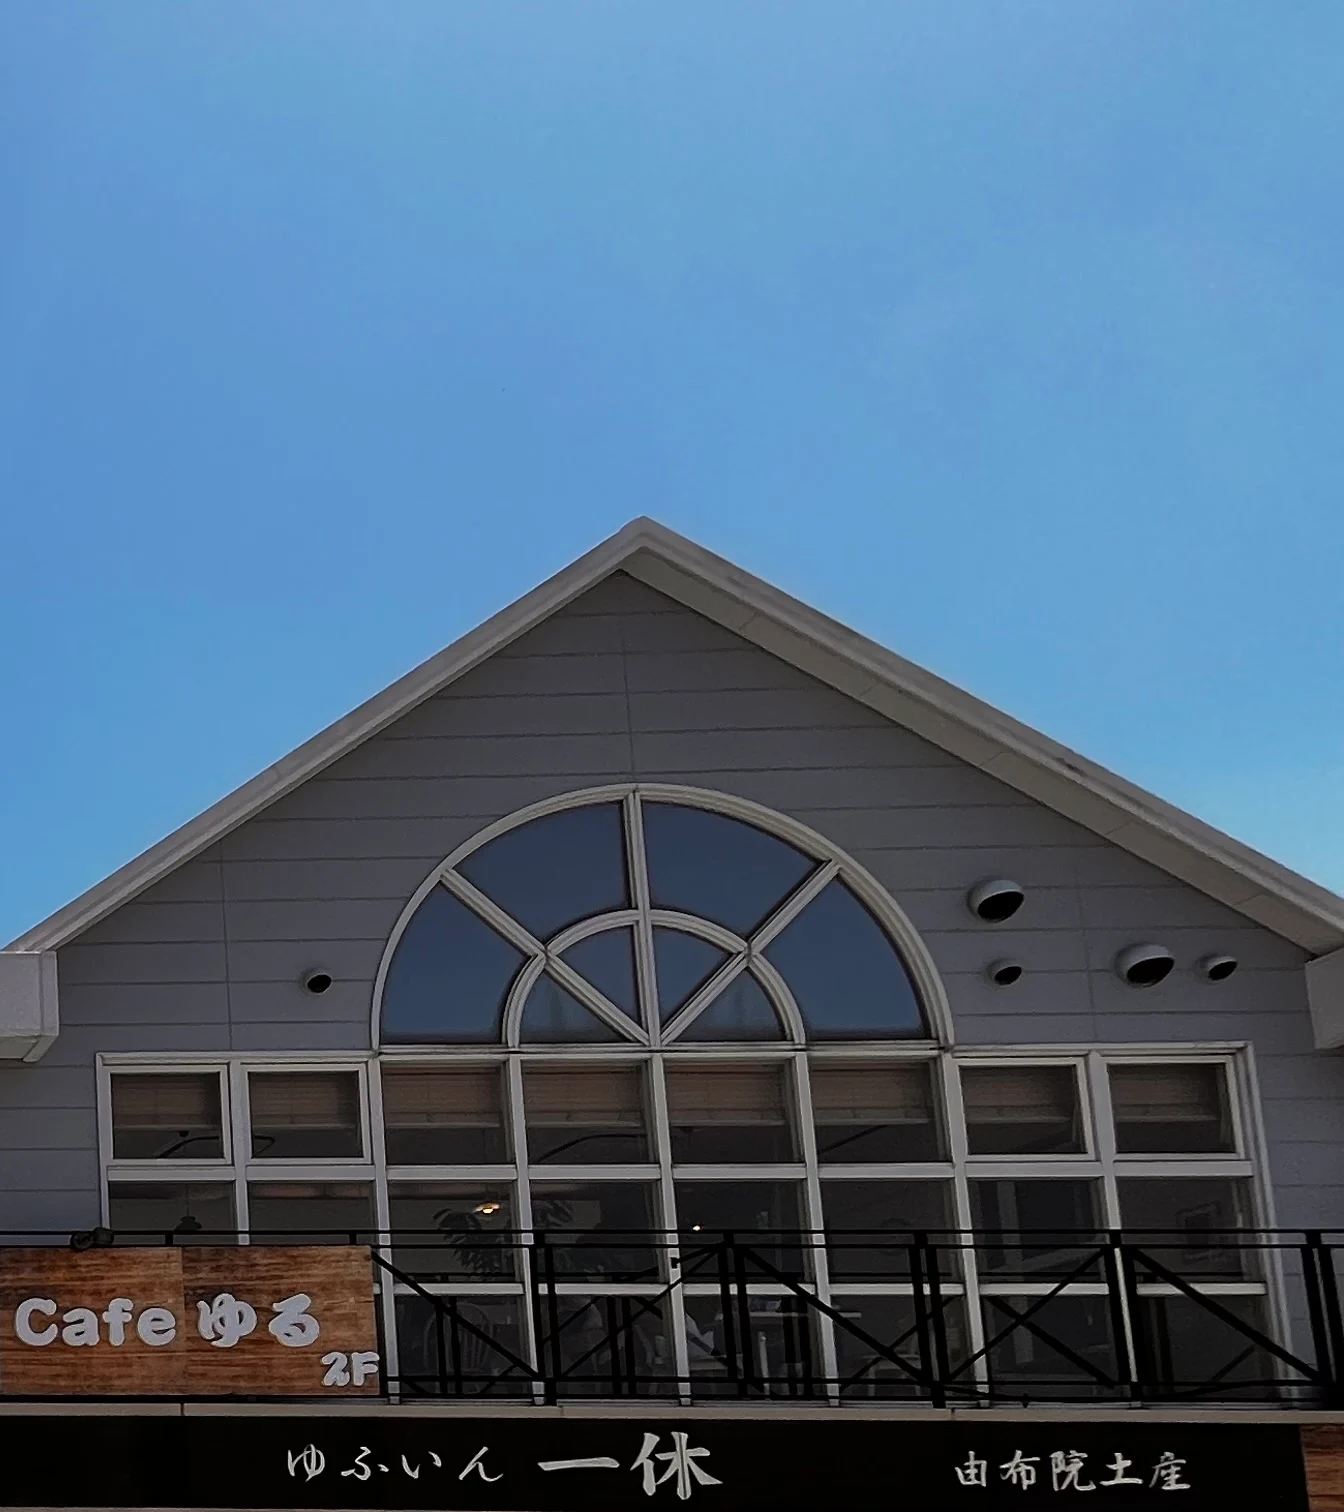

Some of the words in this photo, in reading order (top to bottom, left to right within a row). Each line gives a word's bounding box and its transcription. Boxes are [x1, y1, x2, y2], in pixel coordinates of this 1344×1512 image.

[15, 1297, 177, 1347] Cafe
[196, 1293, 321, 1348] ゆる
[320, 1351, 380, 1387] 2F
[287, 1443, 505, 1483] ゆふいん
[537, 1431, 724, 1501] 一休
[954, 1448, 1192, 1492] 由布院土産
